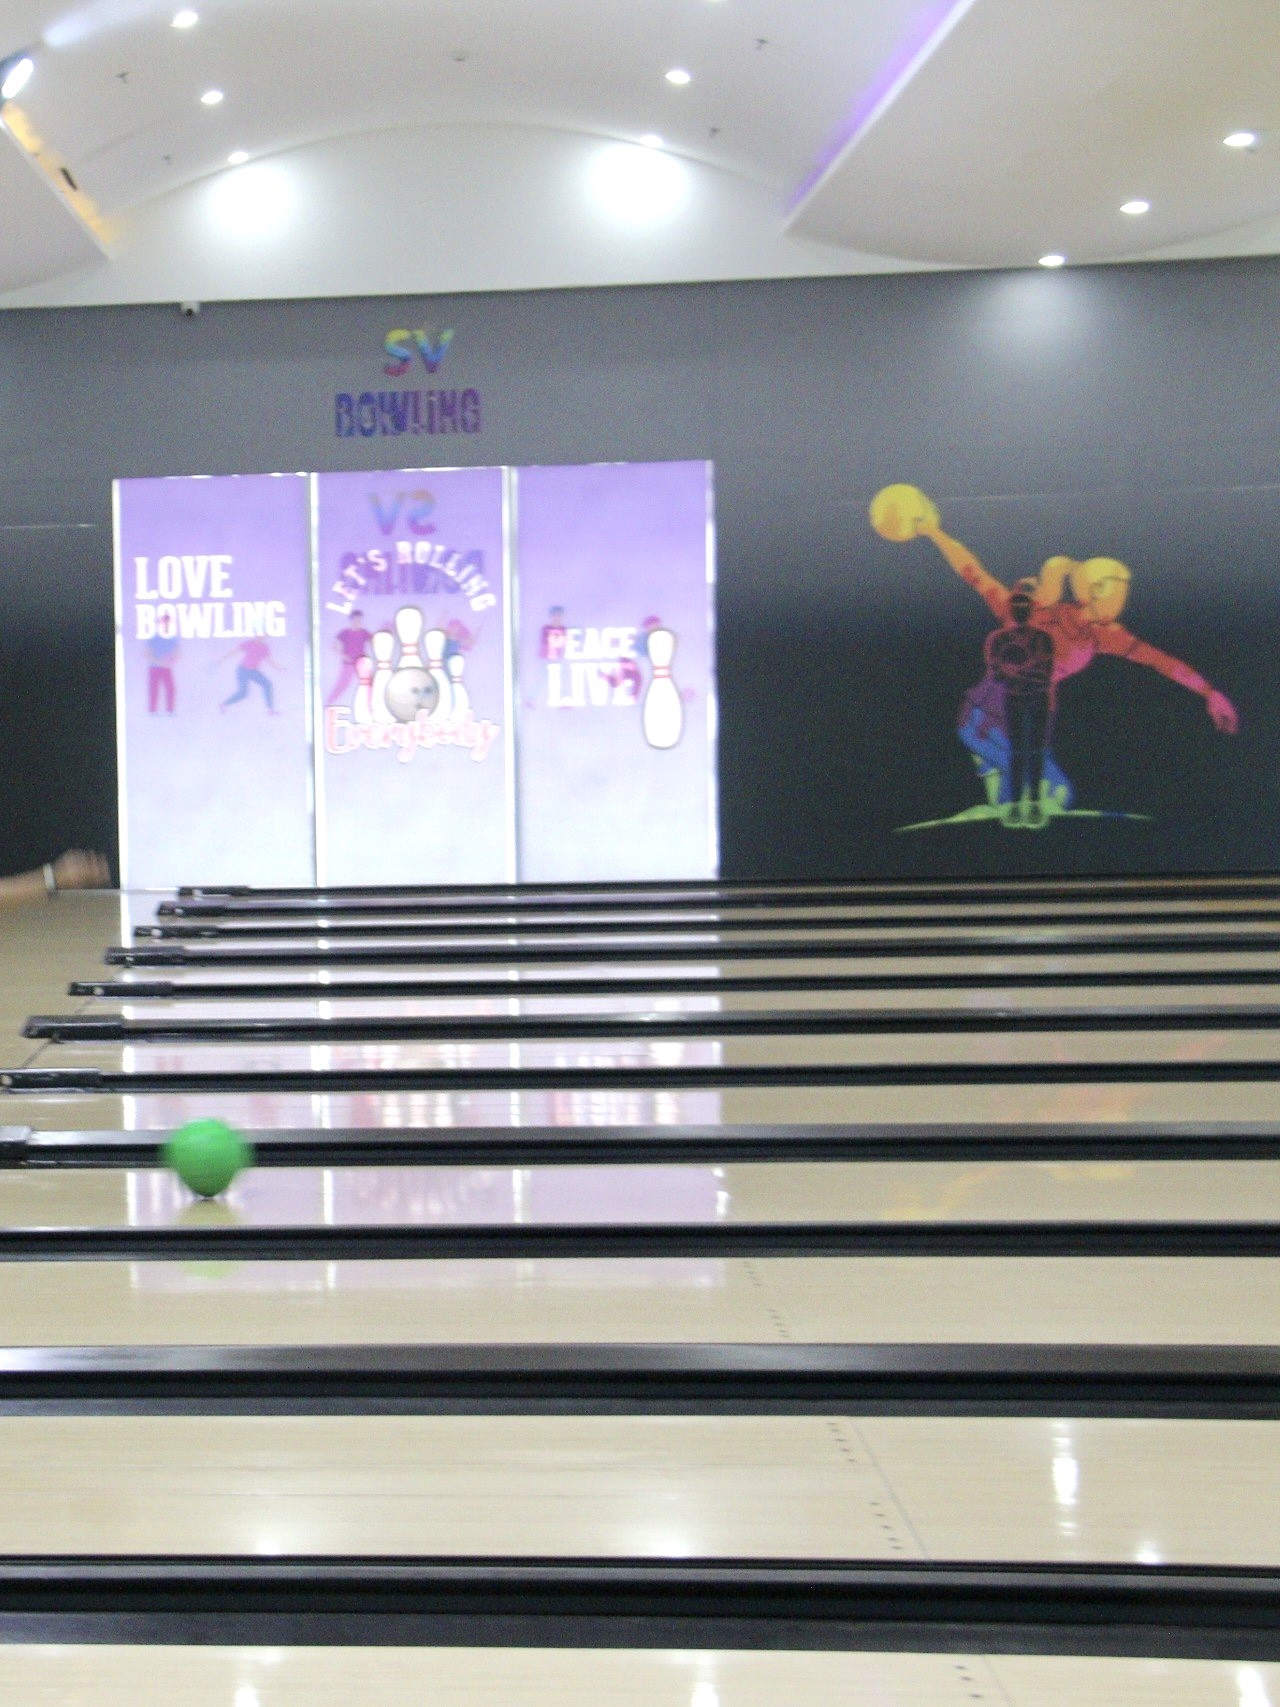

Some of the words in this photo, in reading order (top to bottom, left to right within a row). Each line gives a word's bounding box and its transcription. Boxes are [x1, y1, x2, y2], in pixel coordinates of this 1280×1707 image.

[384, 328, 455, 377] SV
[134, 555, 233, 600] LOVE
[326, 549, 388, 615] LET'S
[395, 540, 497, 611] ROLLING
[135, 600, 287, 640] BOWLING
[547, 626, 637, 660] PEACE
